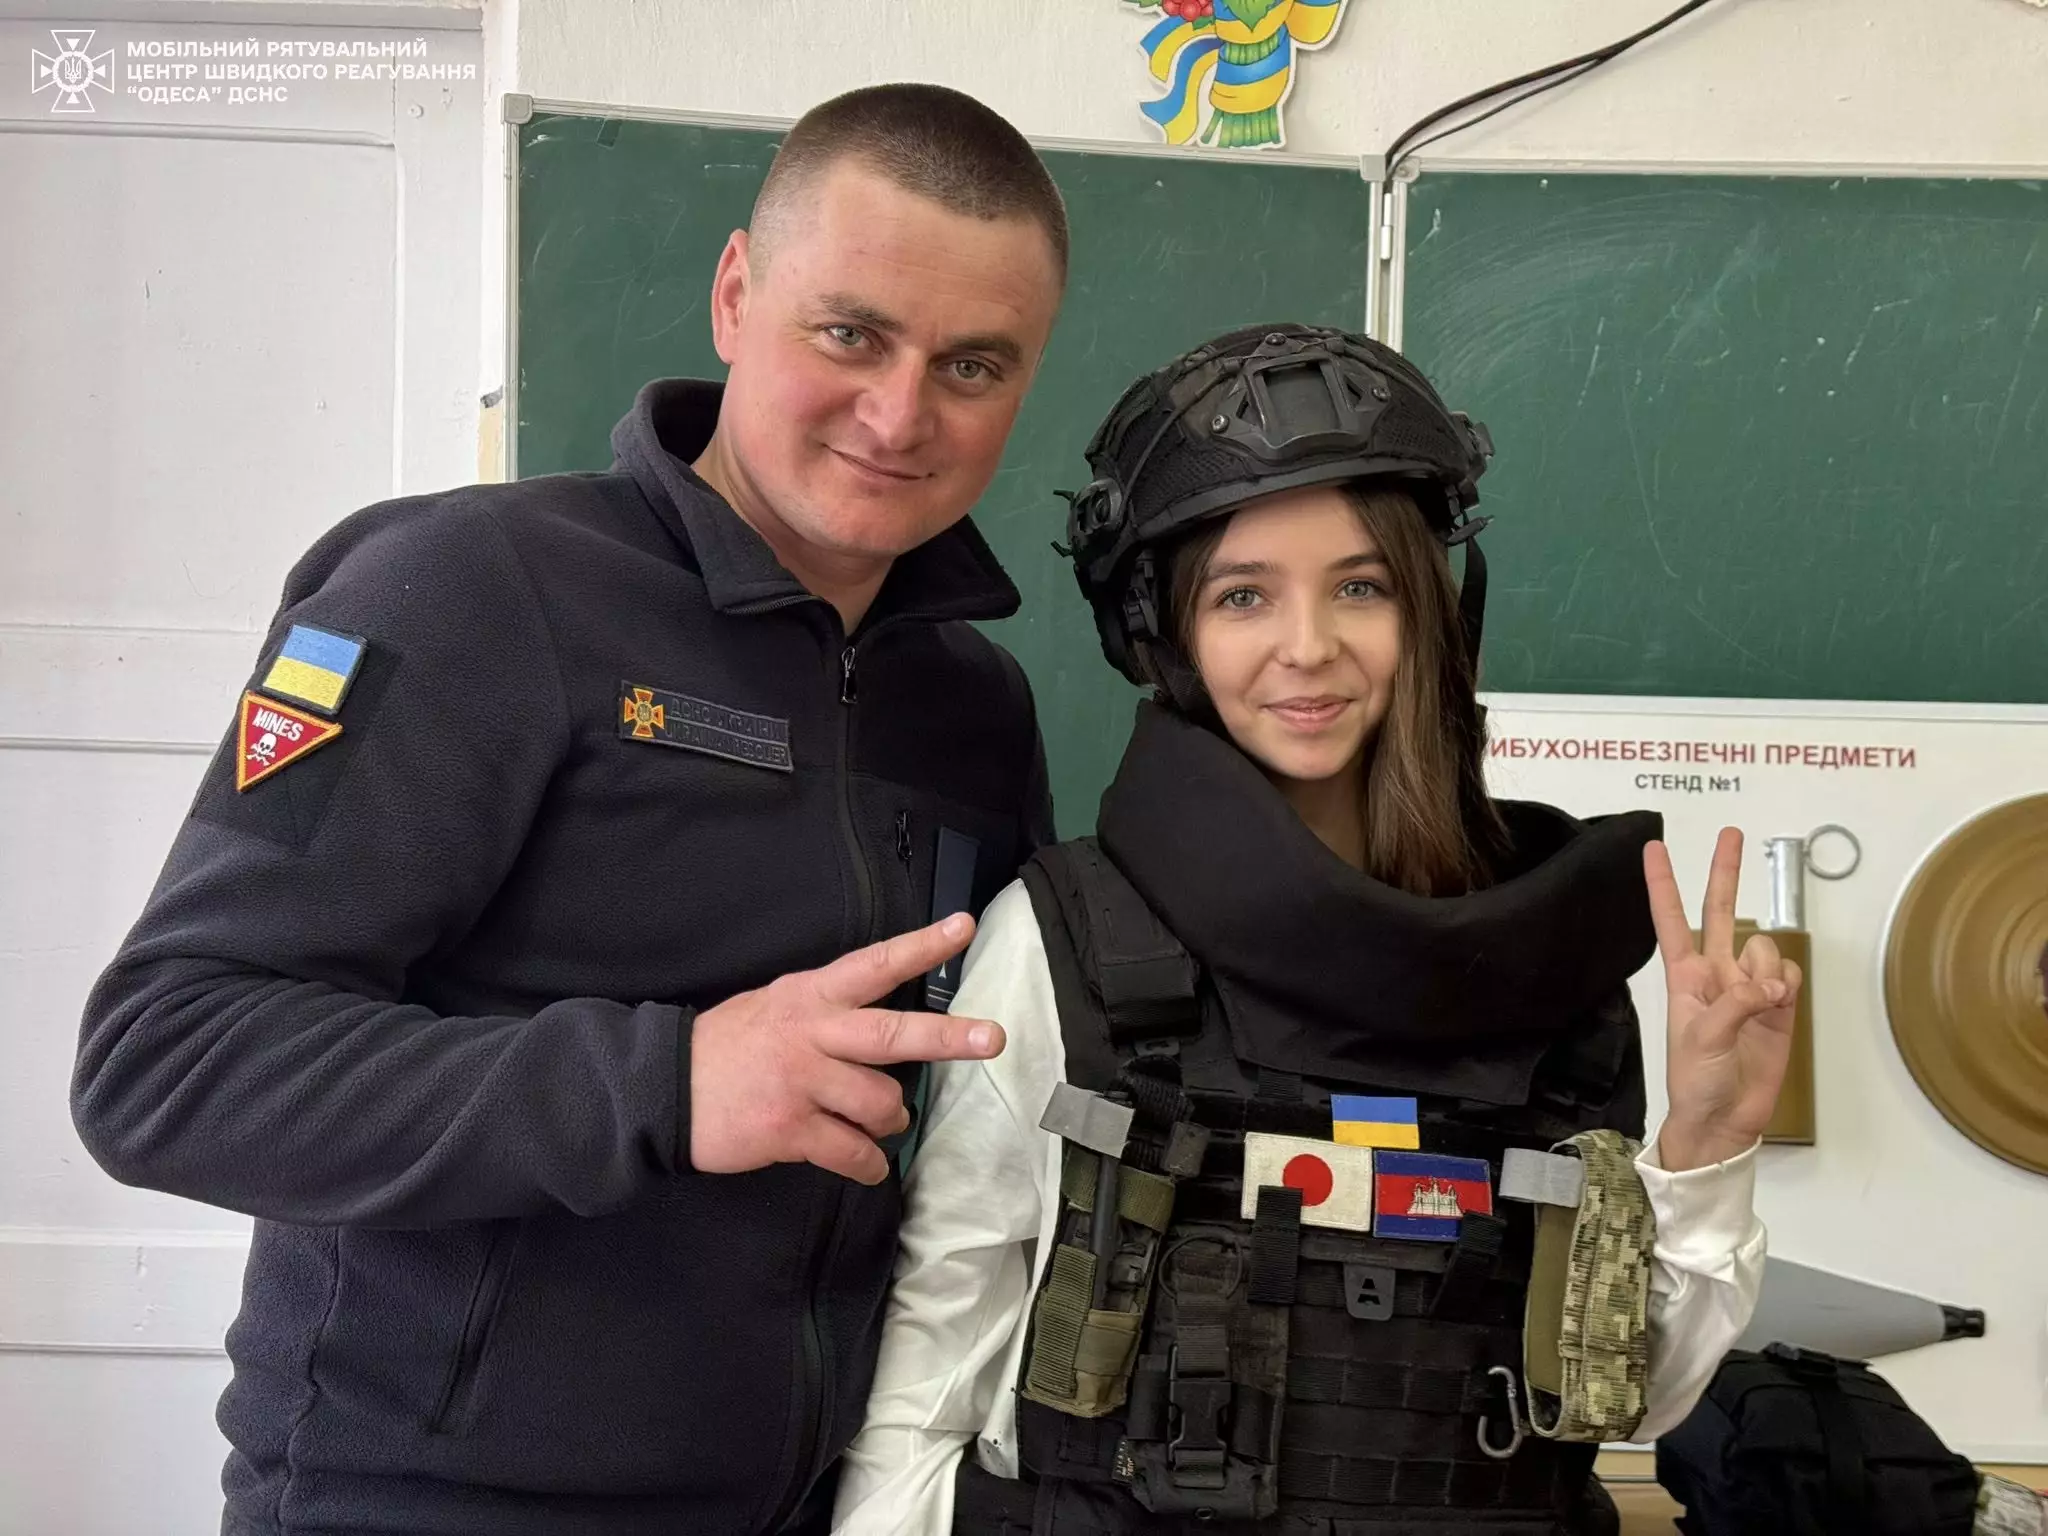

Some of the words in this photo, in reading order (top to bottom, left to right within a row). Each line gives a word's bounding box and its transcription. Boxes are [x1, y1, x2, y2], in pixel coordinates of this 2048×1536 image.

[252, 707, 304, 742] MINES
[1490, 737, 1755, 766] ИБУХОНЕБЕЗПЕЧНІ
[1765, 744, 1917, 770] ПРЕДМЕТИ
[1634, 773, 1702, 793] СТЕНД
[1708, 775, 1742, 792] №1
